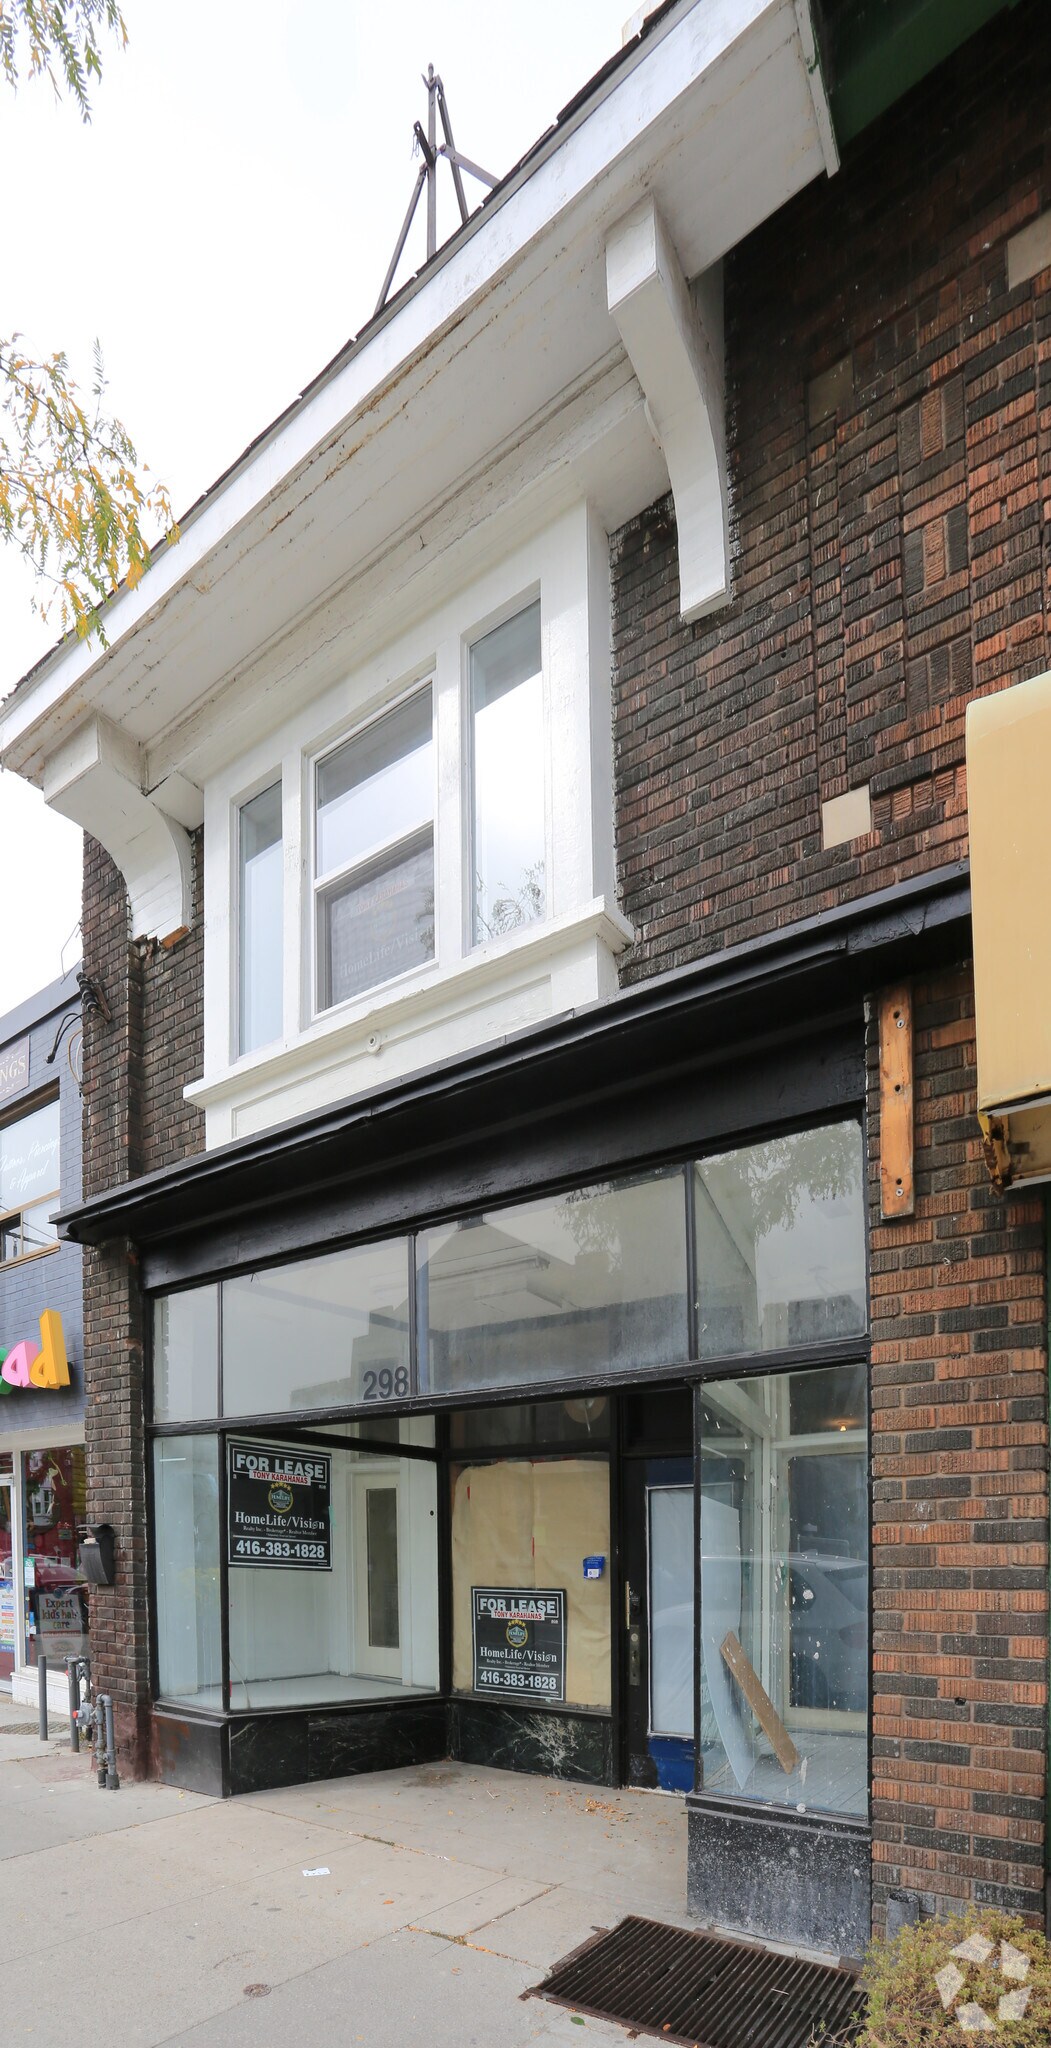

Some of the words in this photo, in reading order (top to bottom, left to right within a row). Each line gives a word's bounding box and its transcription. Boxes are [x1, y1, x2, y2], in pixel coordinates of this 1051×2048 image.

[363, 1366, 409, 1400] 298
[236, 1454, 270, 1471] FOR
[275, 1459, 324, 1479] LEASE
[253, 1470, 270, 1480] TONY
[271, 1472, 308, 1484] KARAHANAS
[235, 1511, 325, 1530] HomeLife/Vision
[236, 1540, 325, 1559] 416-383-1828
[45, 1599, 74, 1609] Expert
[480, 1598, 506, 1612] FOR
[511, 1600, 556, 1614] LEASE
[53, 1621, 70, 1629] care
[480, 1647, 557, 1662] HomeLife/Vision
[480, 1671, 557, 1690] 416-383-1828
